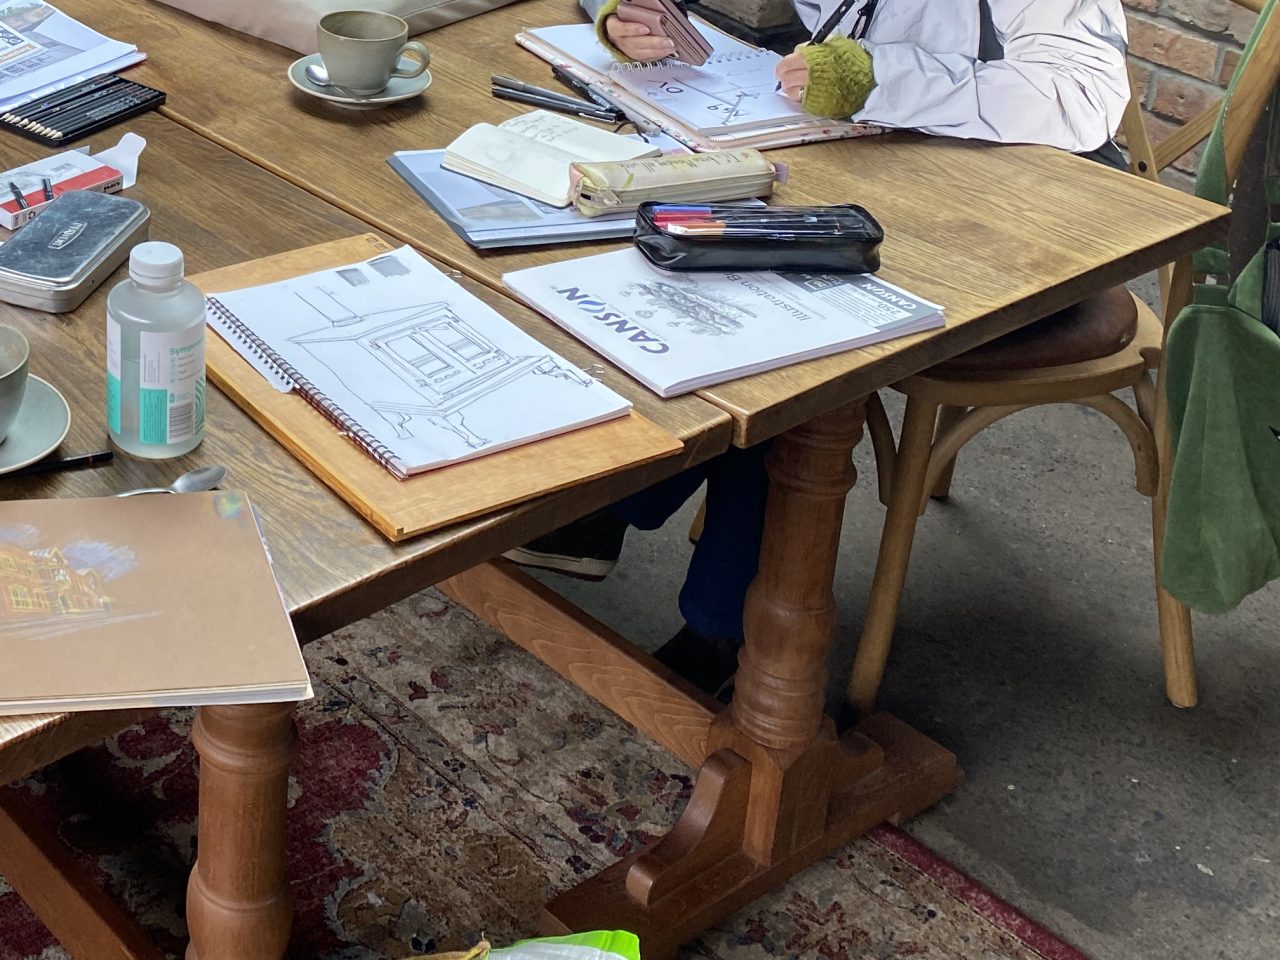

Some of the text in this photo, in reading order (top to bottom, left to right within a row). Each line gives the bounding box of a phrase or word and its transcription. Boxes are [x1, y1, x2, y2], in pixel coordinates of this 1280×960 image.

[741, 281, 811, 321] Illustration
[862, 283, 917, 310] CANSON
[556, 287, 670, 354] CANSON
